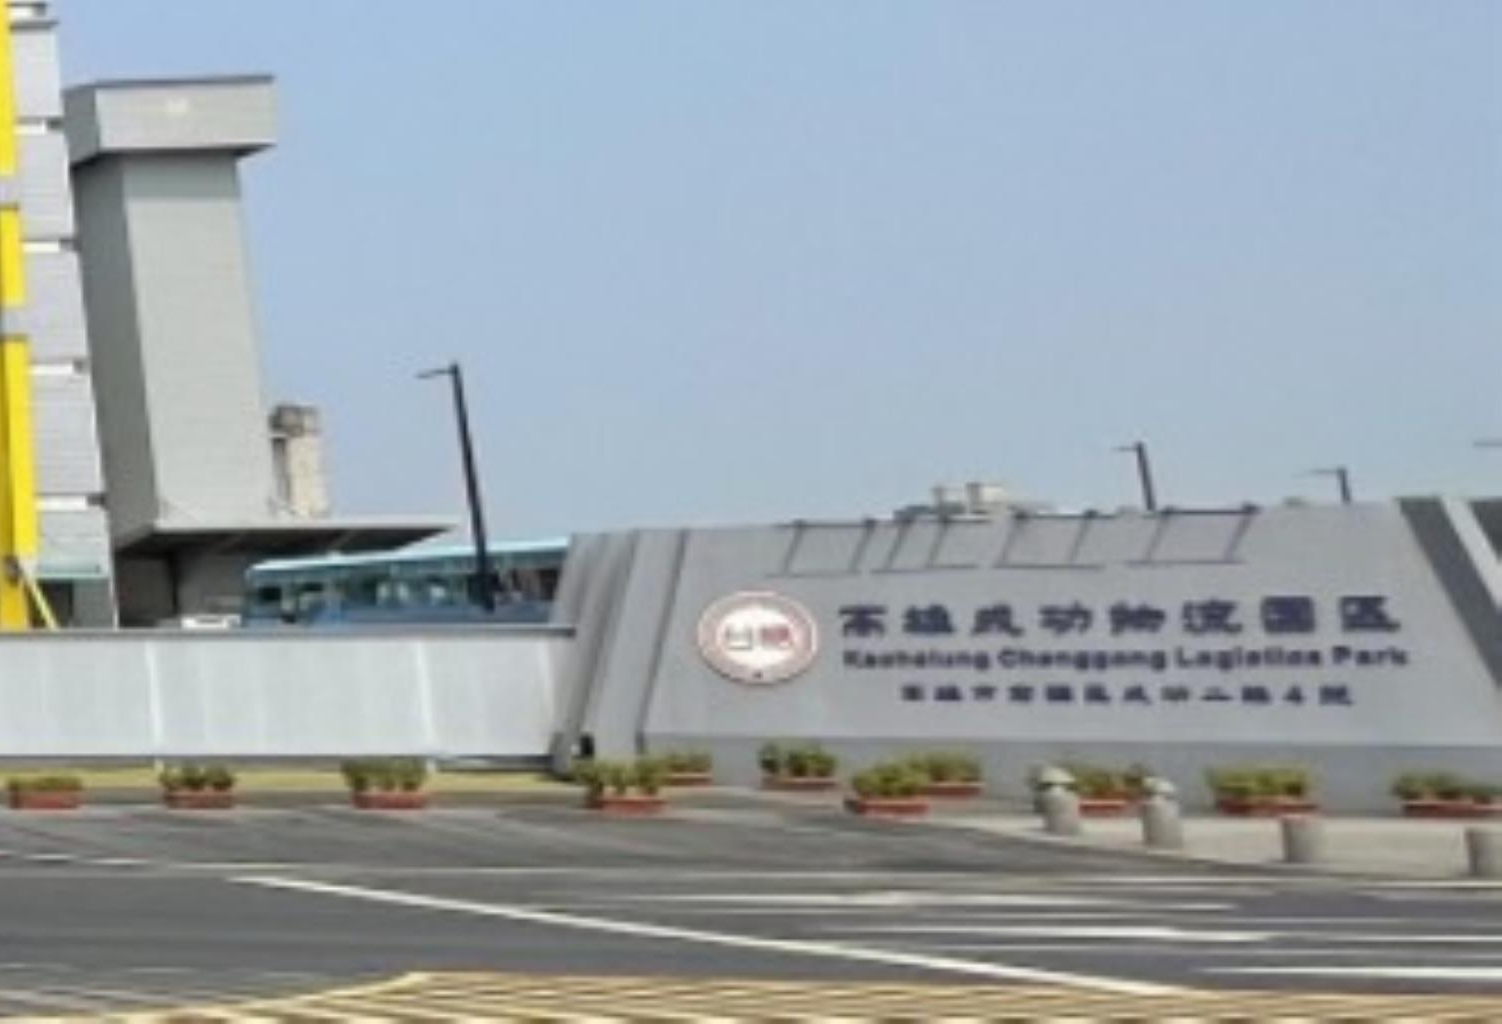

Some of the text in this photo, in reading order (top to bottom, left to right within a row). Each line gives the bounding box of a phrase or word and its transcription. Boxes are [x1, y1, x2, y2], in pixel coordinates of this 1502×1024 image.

[838, 595, 1401, 637] 高雄成功物流園區
[845, 645, 1408, 672] Kaohsiung Chenggong Logistics Park
